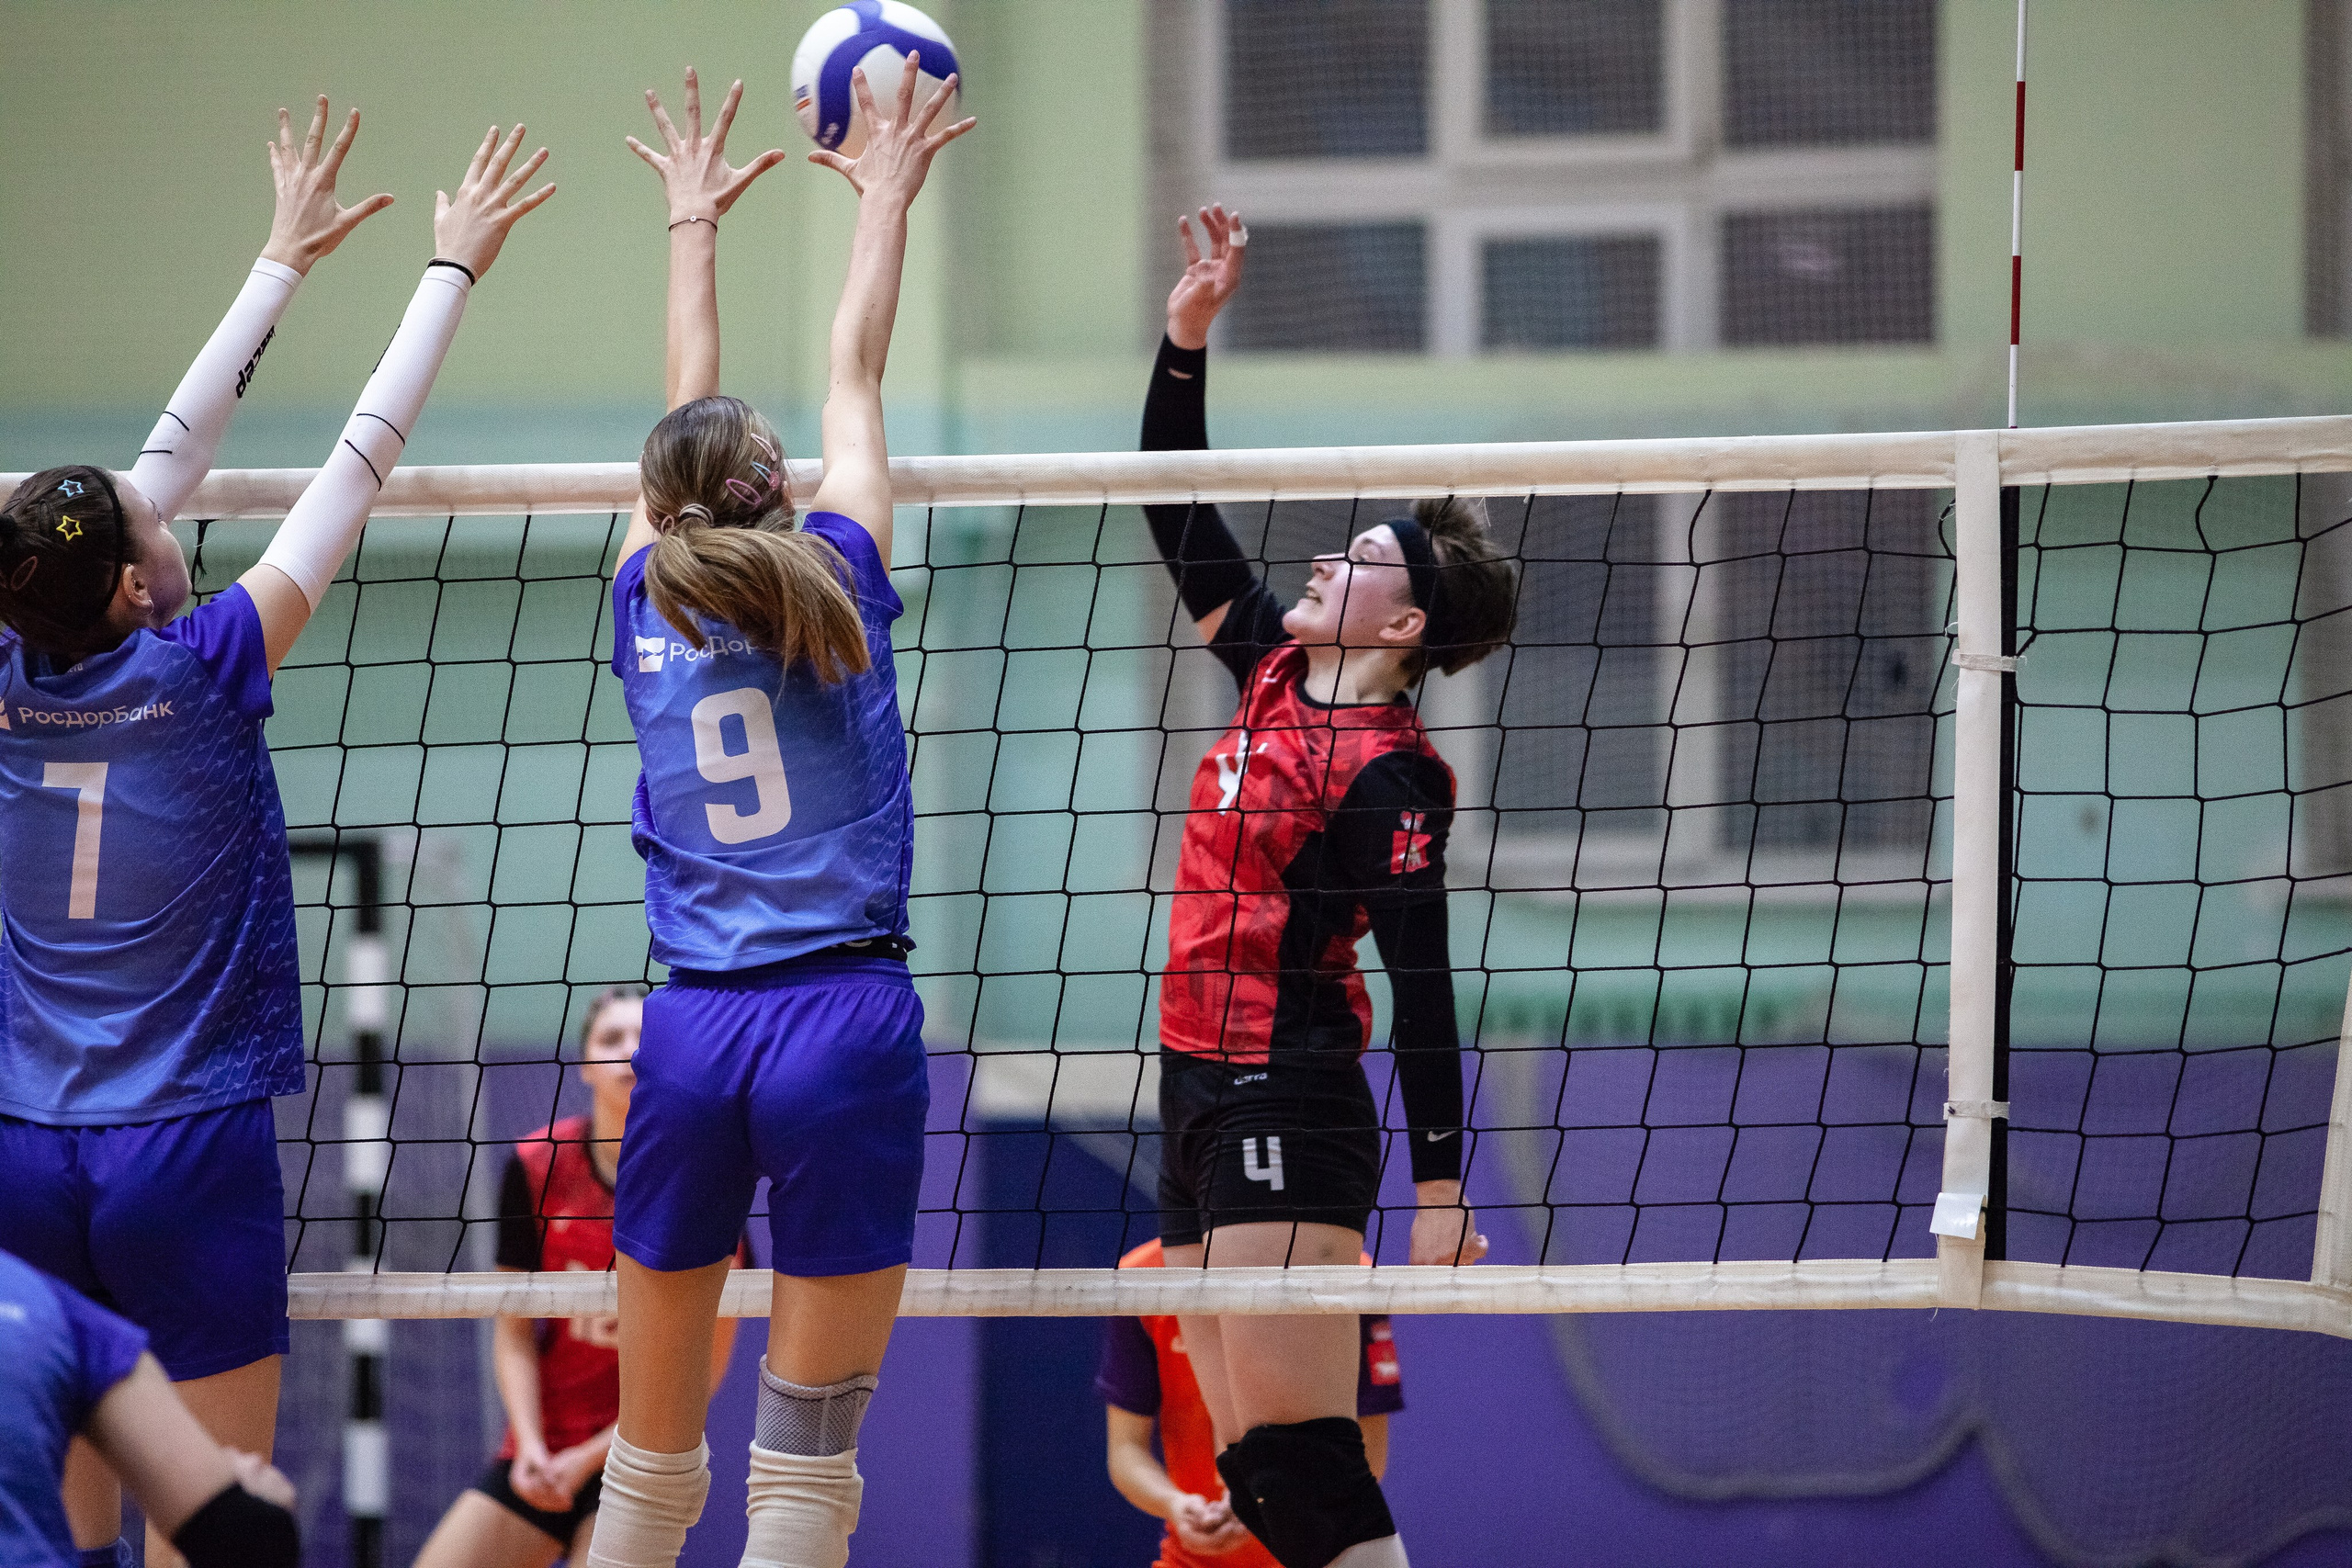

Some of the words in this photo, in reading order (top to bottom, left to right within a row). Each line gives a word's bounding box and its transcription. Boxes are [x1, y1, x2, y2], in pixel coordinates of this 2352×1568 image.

[41, 761, 108, 919] 7
[691, 687, 792, 844] 9
[1242, 1136, 1284, 1190] 4
